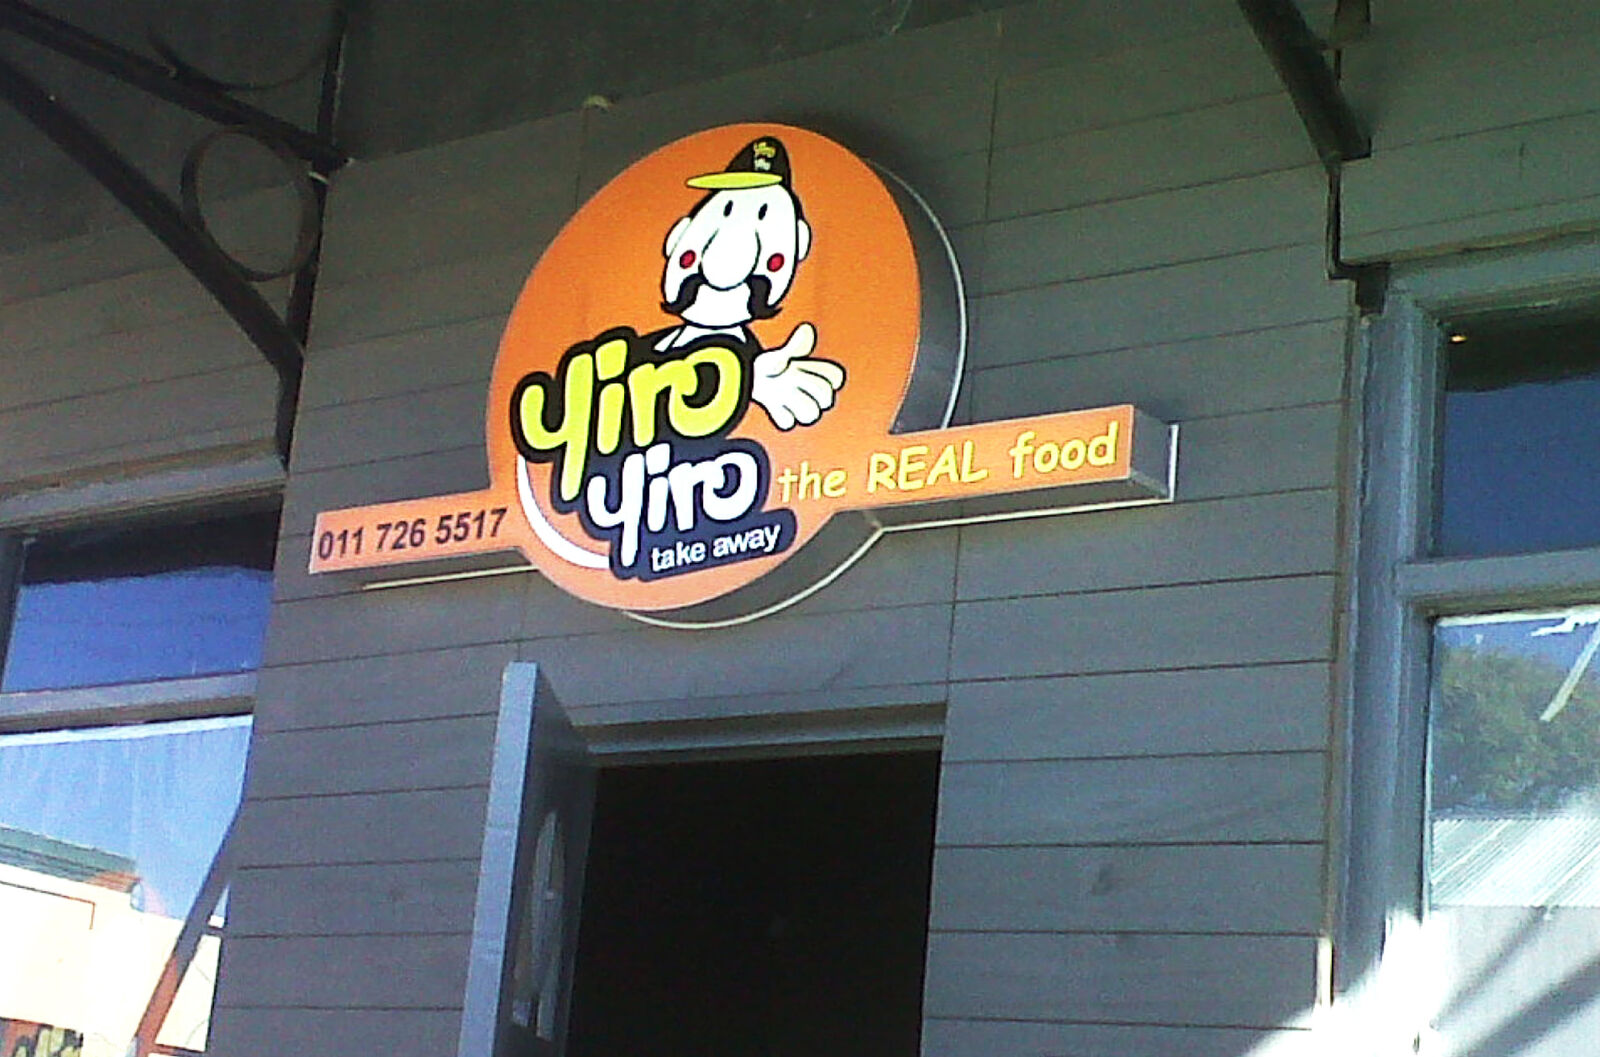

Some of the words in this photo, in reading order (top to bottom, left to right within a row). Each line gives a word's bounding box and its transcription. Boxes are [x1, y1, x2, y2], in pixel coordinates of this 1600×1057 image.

[777, 461, 848, 503] the
[867, 440, 988, 494] REAL
[1009, 420, 1119, 478] food
[318, 526, 365, 560] 011
[375, 518, 426, 550] 726
[434, 507, 508, 545] 5517
[651, 541, 706, 572] take
[712, 524, 781, 557] away
